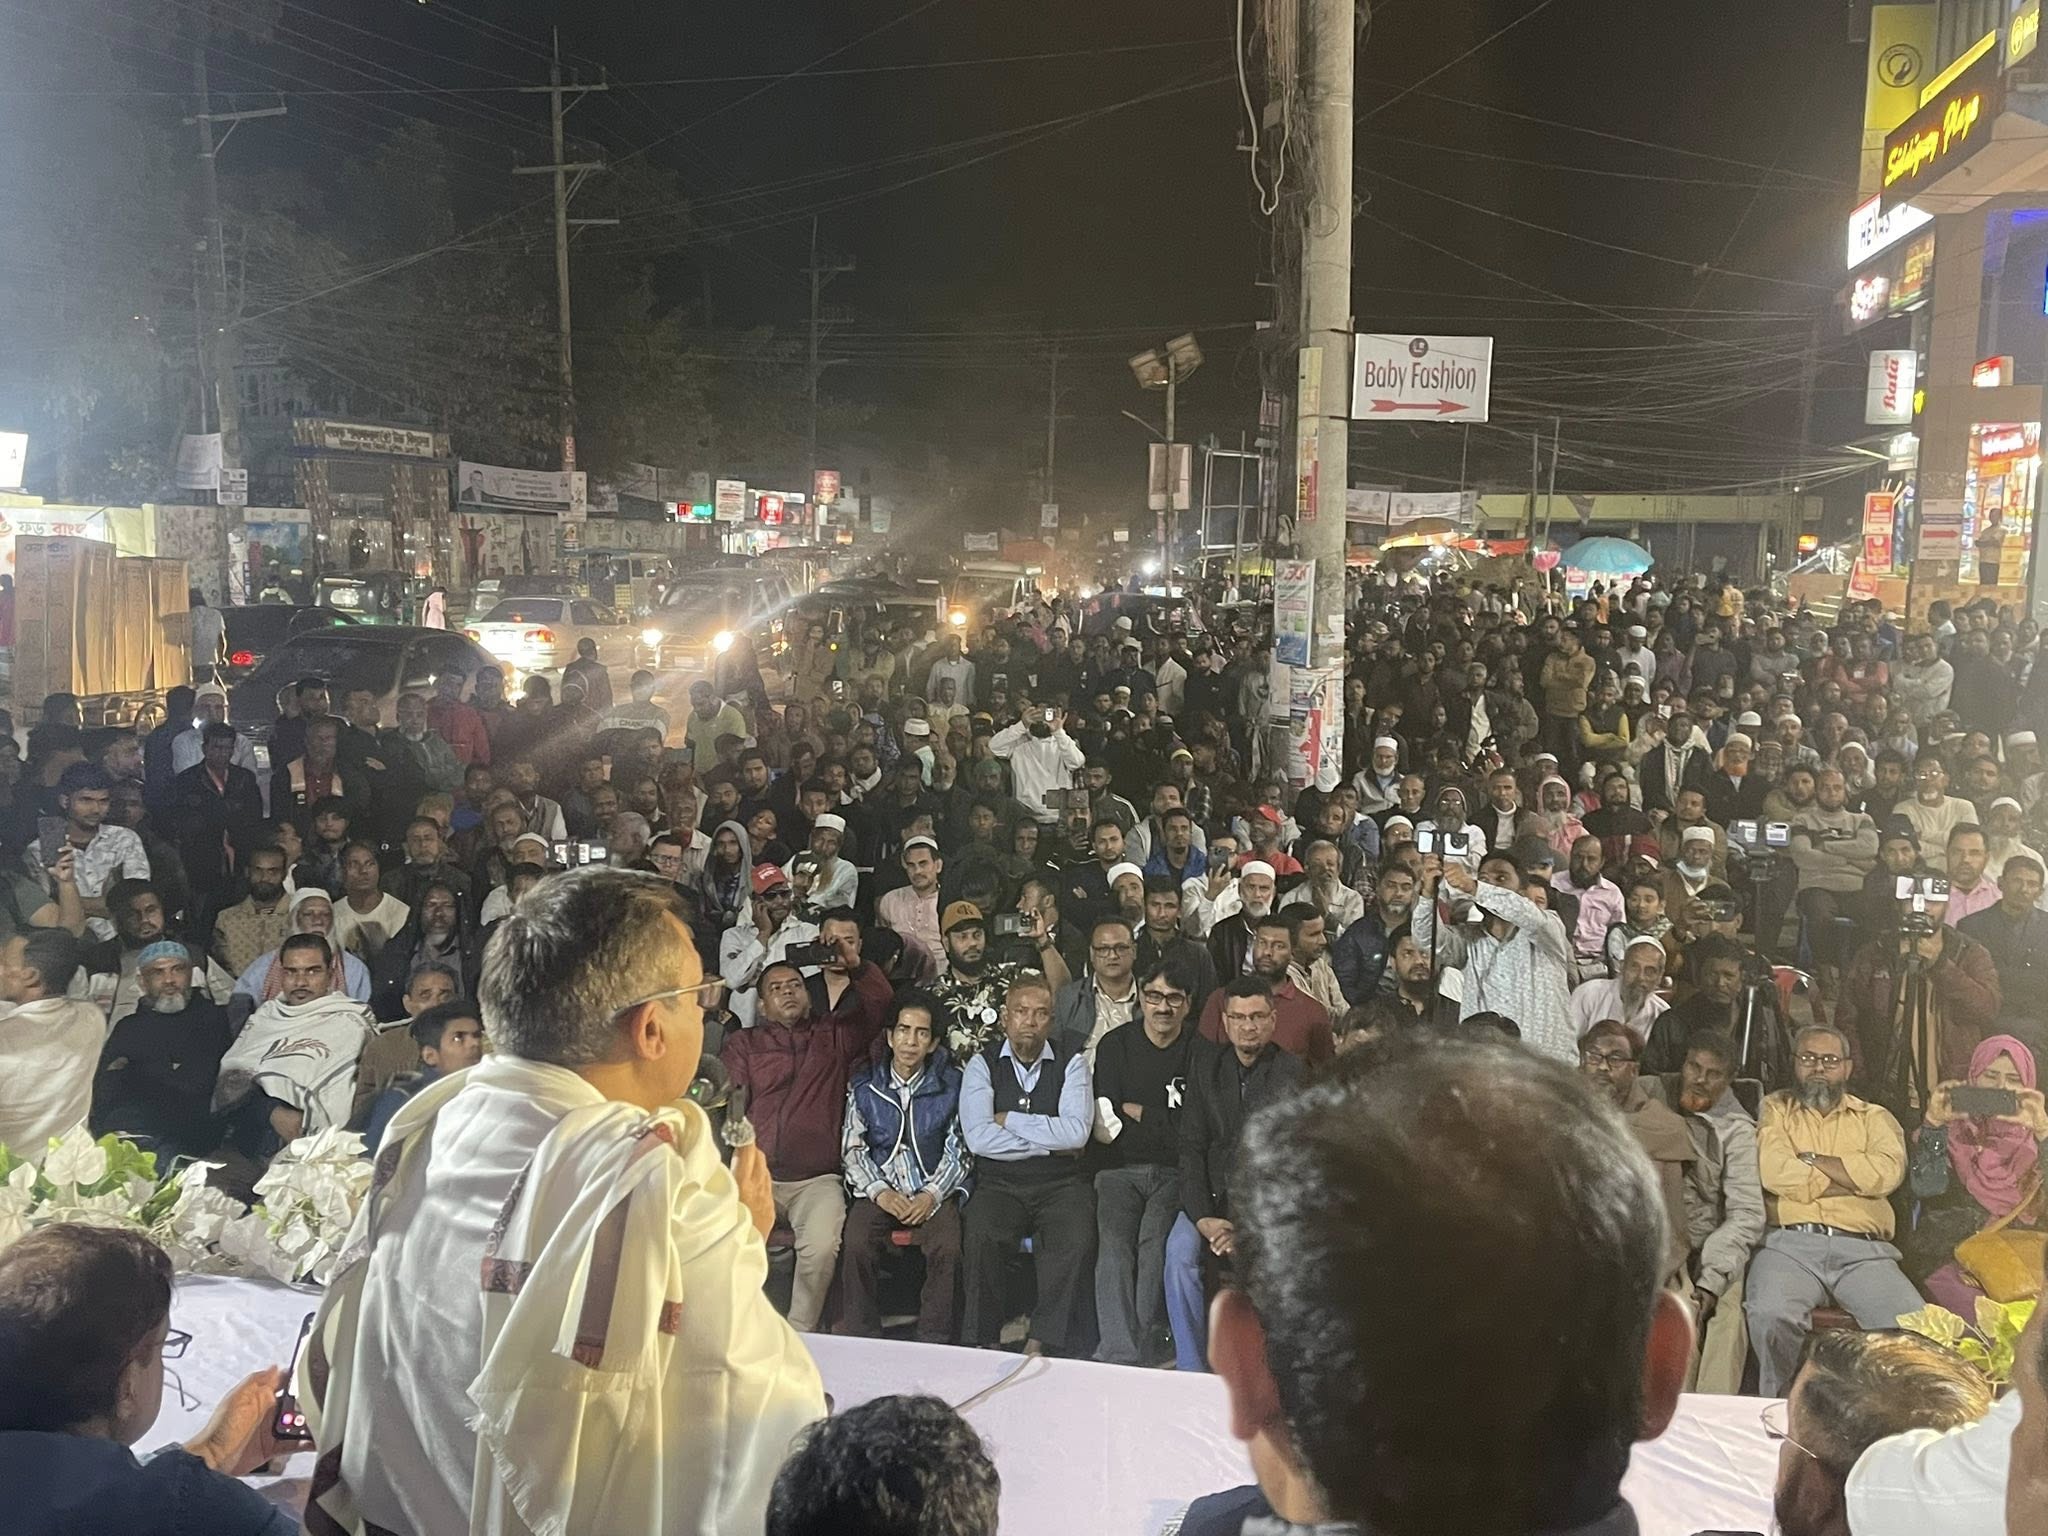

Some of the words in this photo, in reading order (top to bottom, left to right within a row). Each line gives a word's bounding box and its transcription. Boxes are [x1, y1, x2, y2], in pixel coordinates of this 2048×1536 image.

[1365, 358, 1407, 397] Baby
[1411, 360, 1477, 393] Fashion
[1883, 358, 1900, 412] Bata
